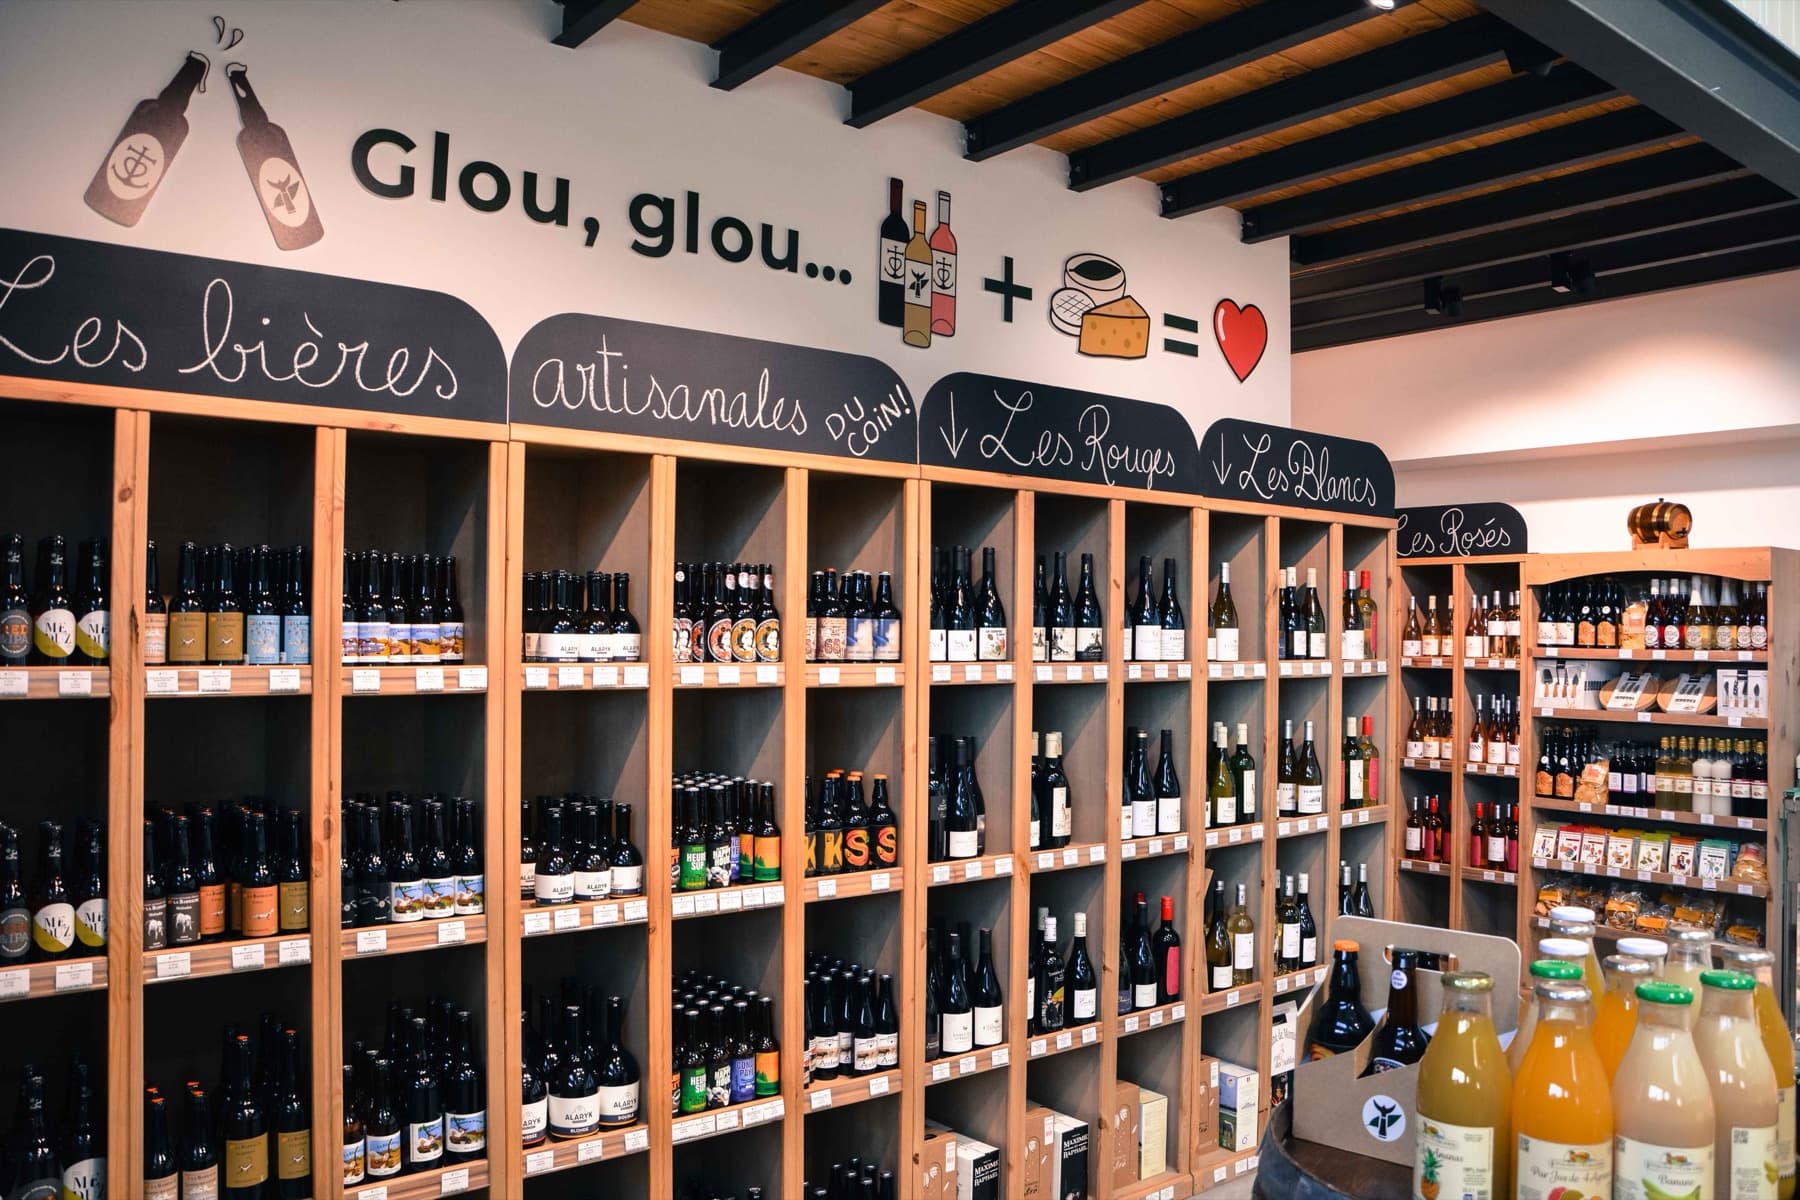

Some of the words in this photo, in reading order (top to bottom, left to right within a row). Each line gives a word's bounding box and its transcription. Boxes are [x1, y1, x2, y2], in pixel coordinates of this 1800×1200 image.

[351, 128, 600, 248] Glou,
[628, 190, 852, 286] glou...
[0, 255, 147, 373] Les
[178, 278, 458, 400] bières
[532, 334, 808, 436] artisanales
[825, 396, 865, 440] DU
[980, 389, 1073, 467] Les
[1079, 404, 1176, 490] Rouges
[1239, 433, 1289, 500] Les
[1288, 440, 1377, 507] Blancs
[1396, 513, 1435, 557] Les
[1440, 508, 1511, 557] Rosés
[522, 1117, 541, 1127] ARYK
[564, 1111, 593, 1121] ALARYK
